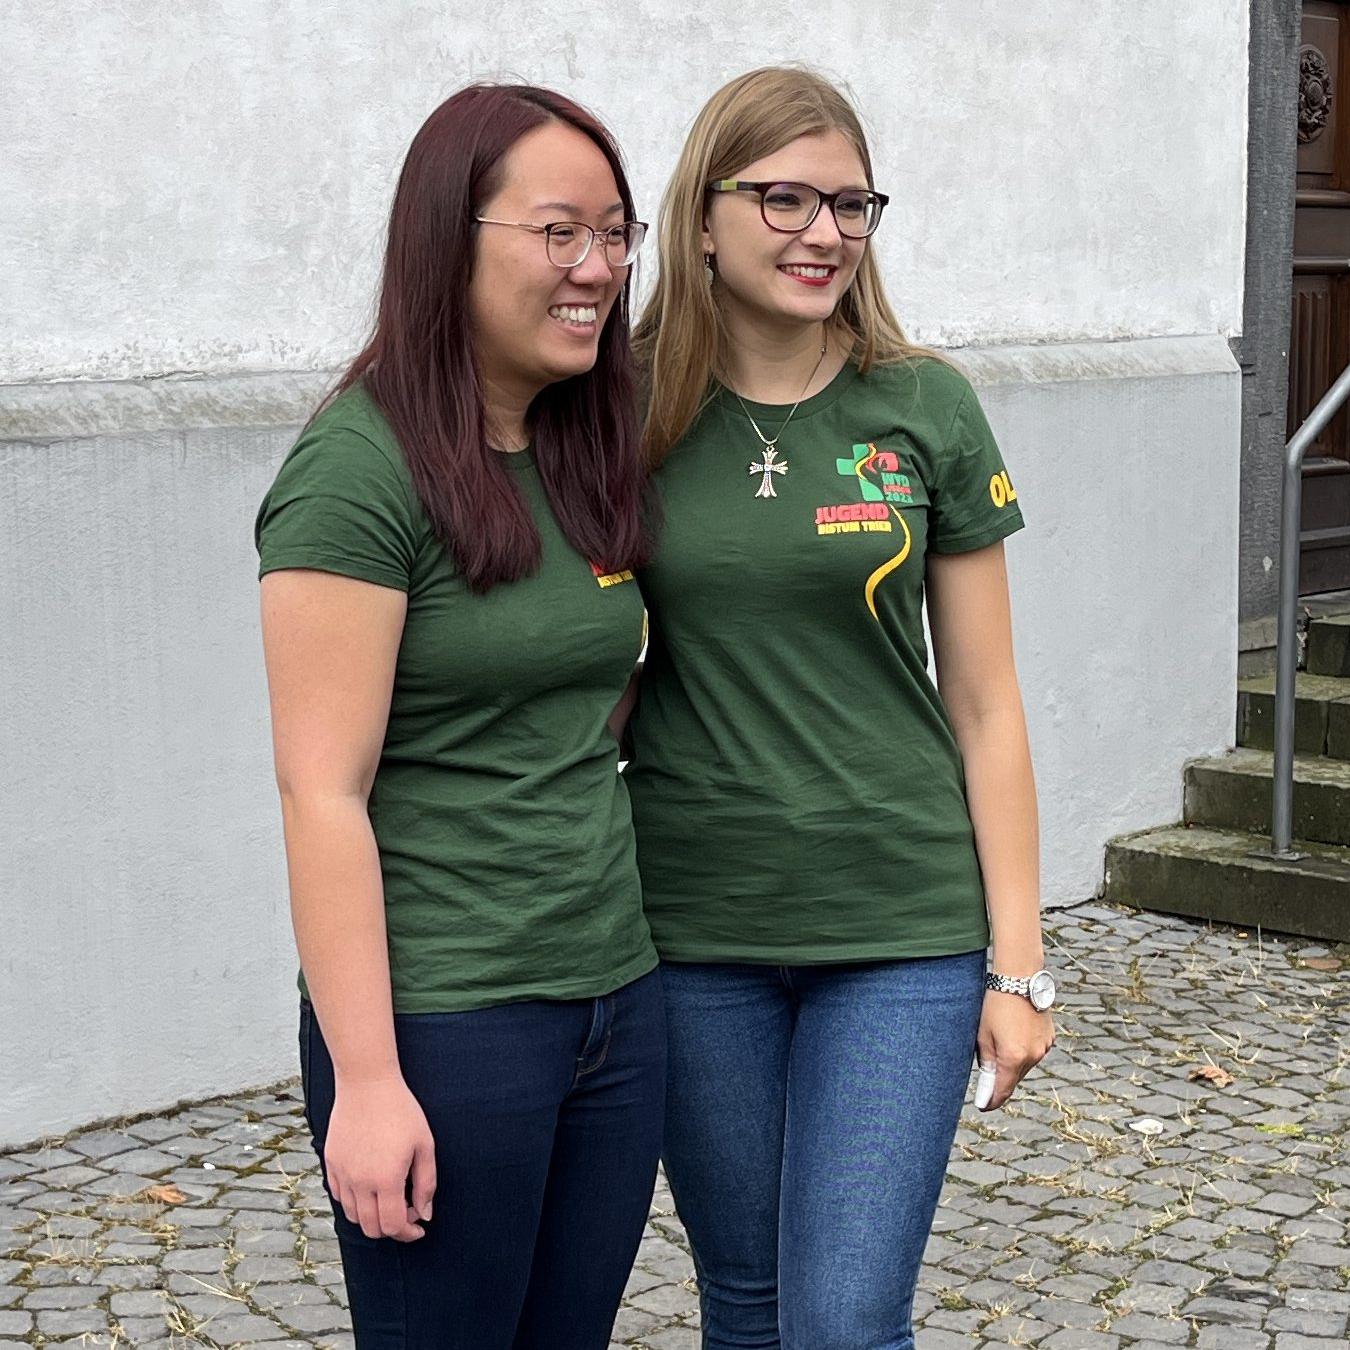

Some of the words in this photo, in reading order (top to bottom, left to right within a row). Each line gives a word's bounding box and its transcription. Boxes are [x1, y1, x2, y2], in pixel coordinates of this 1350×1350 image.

[814, 502, 890, 524] JUGEND
[817, 521, 860, 536] BISTUM
[861, 520, 892, 533] TRIER
